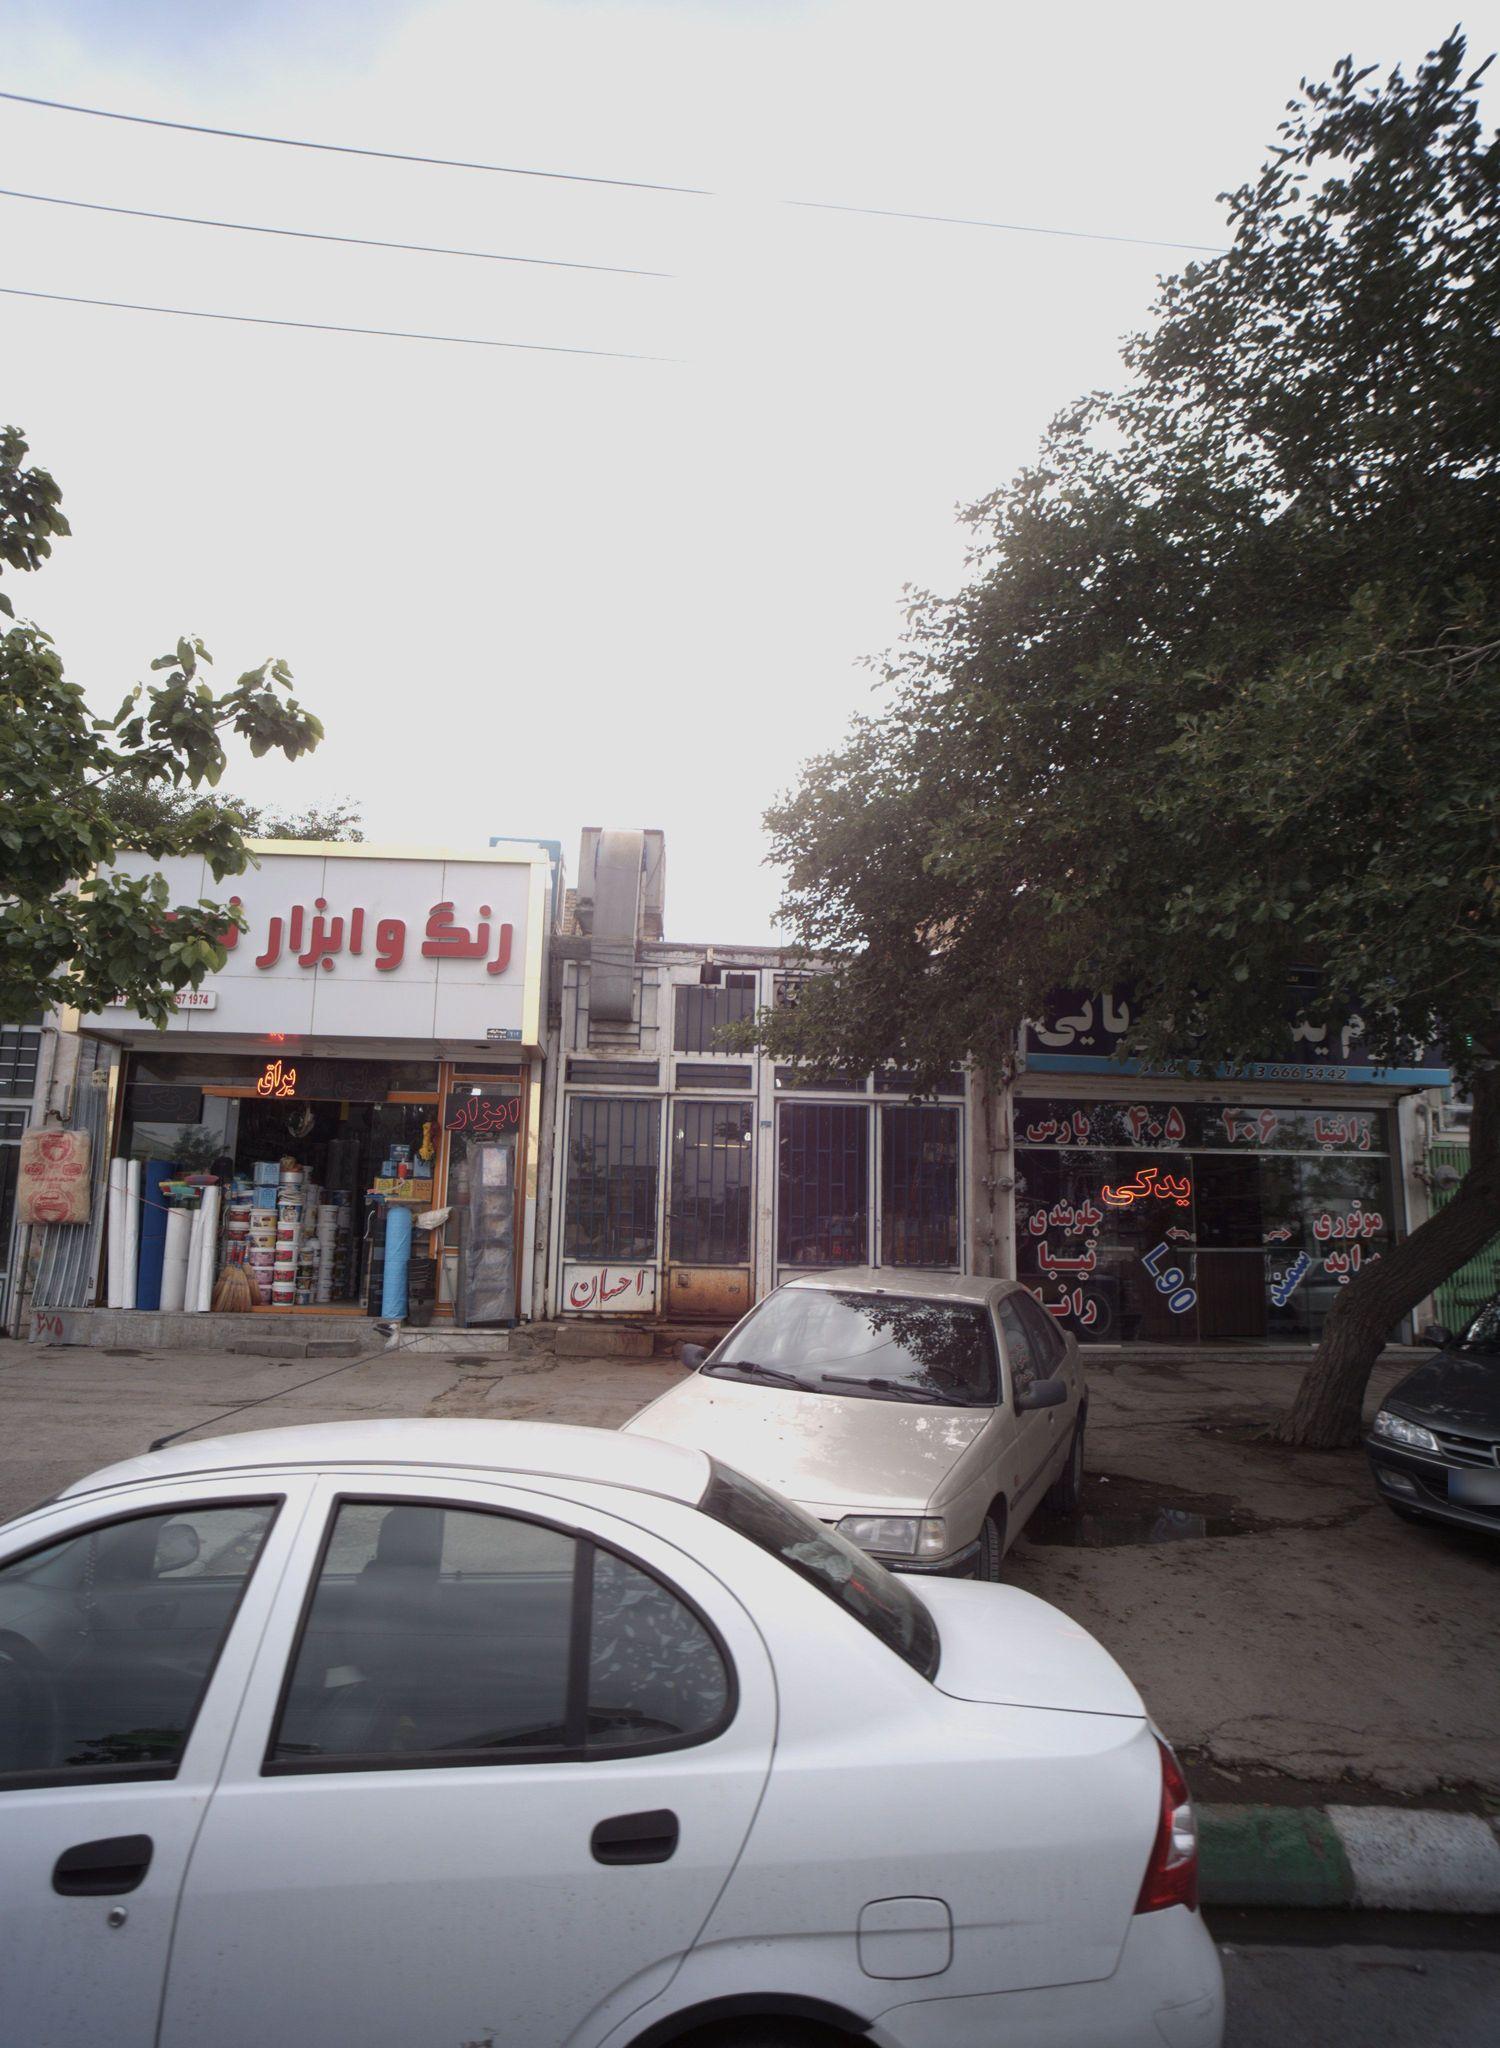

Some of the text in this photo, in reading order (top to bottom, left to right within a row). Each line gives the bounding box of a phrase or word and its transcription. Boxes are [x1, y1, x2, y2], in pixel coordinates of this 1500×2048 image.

[255, 896, 364, 971] ابزار
[374, 918, 406, 972] و
[420, 901, 513, 974] رنگ
[188, 993, 209, 1005] 1974
[257, 1059, 297, 1097] یراق
[446, 1096, 521, 1130] ابزار
[1027, 1105, 1371, 1151] زانتیا ۲۰۶ ۴۰۵ پارس
[1101, 1167, 1191, 1207] یدکی
[1313, 1200, 1383, 1240] موتوری
[1038, 1240, 1097, 1280] تیبا
[1141, 1242, 1197, 1314] L90
[1271, 1250, 1312, 1307] سمند
[570, 1267, 645, 1309] احسان
